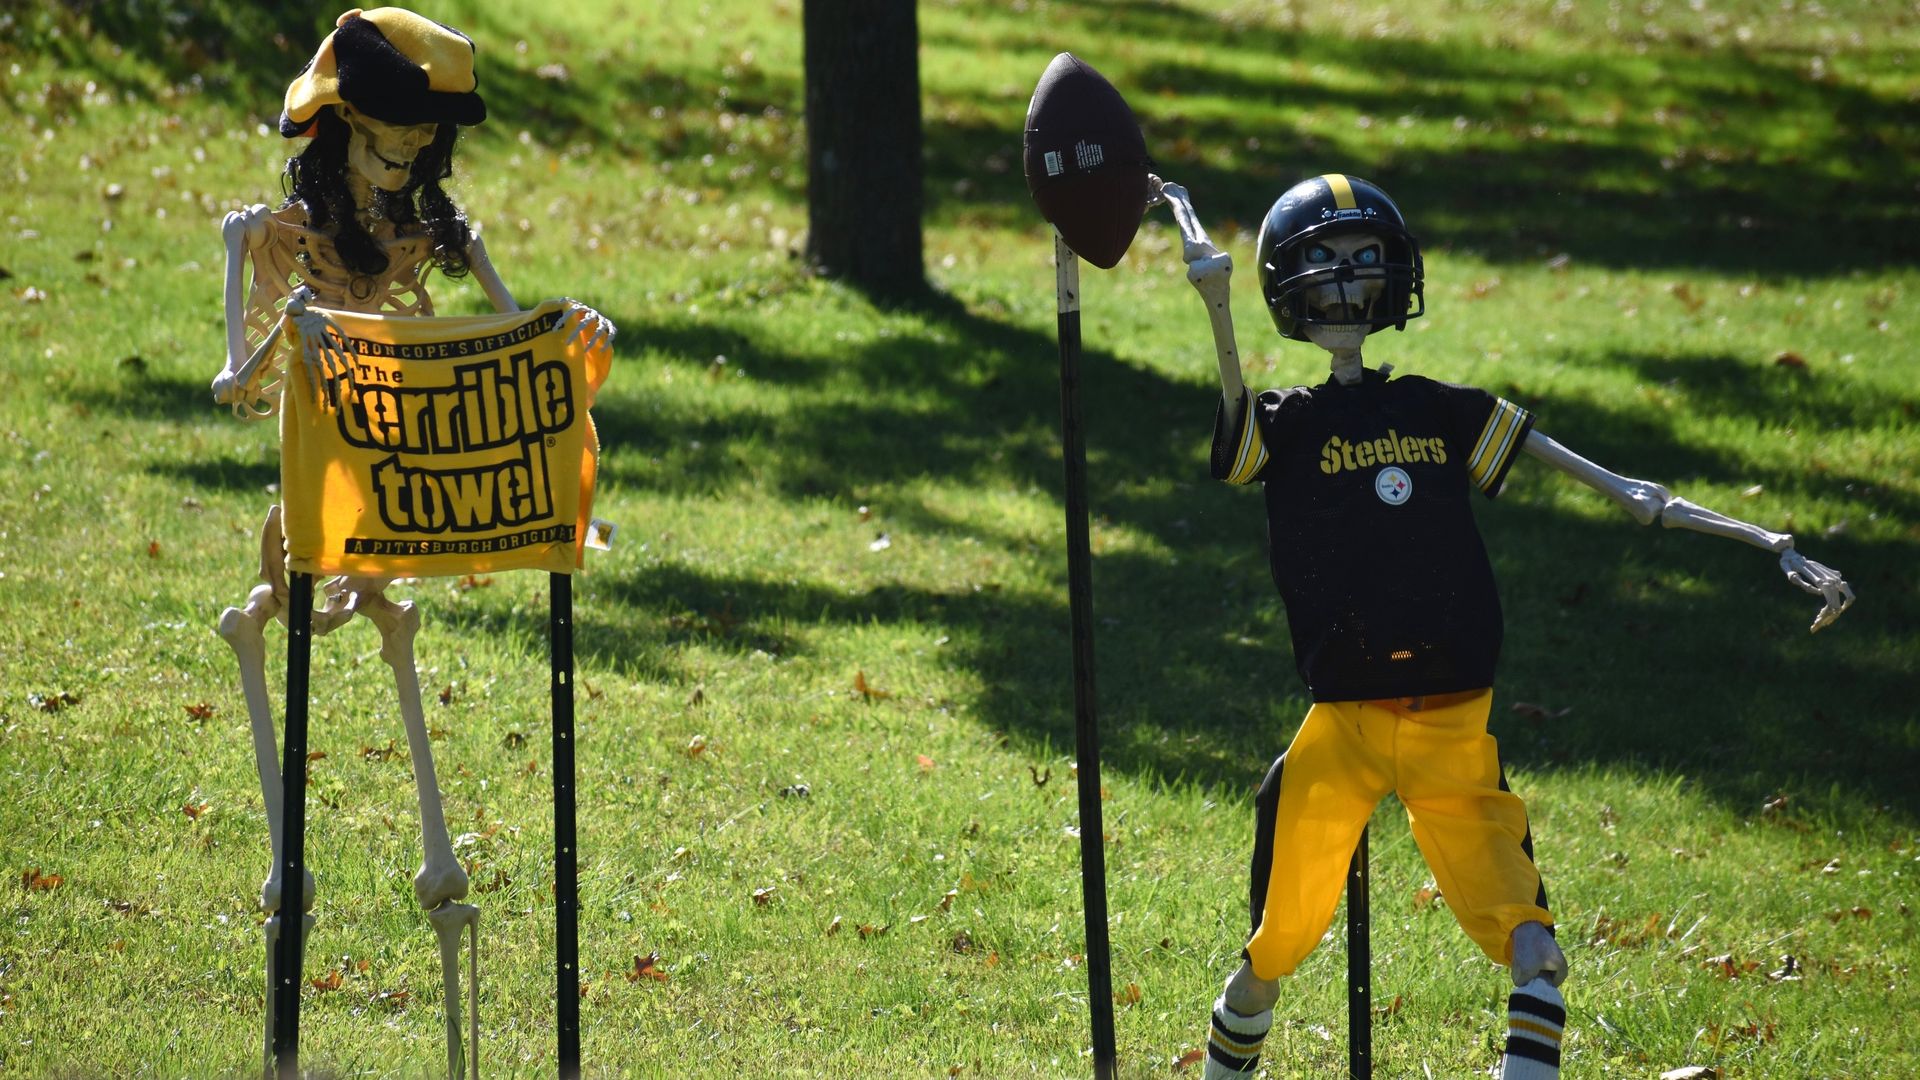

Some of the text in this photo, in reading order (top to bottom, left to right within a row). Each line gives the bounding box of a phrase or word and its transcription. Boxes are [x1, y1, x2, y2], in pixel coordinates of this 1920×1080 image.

[401, 342, 468, 359] COPE'S
[474, 317, 551, 351] OFFICIAL
[359, 364, 404, 383] The
[327, 349, 575, 455] terrible
[1320, 428, 1447, 474] Steelers
[370, 435, 554, 534] towel
[353, 527, 577, 555] A PITTSBURGH ORIGINAL
